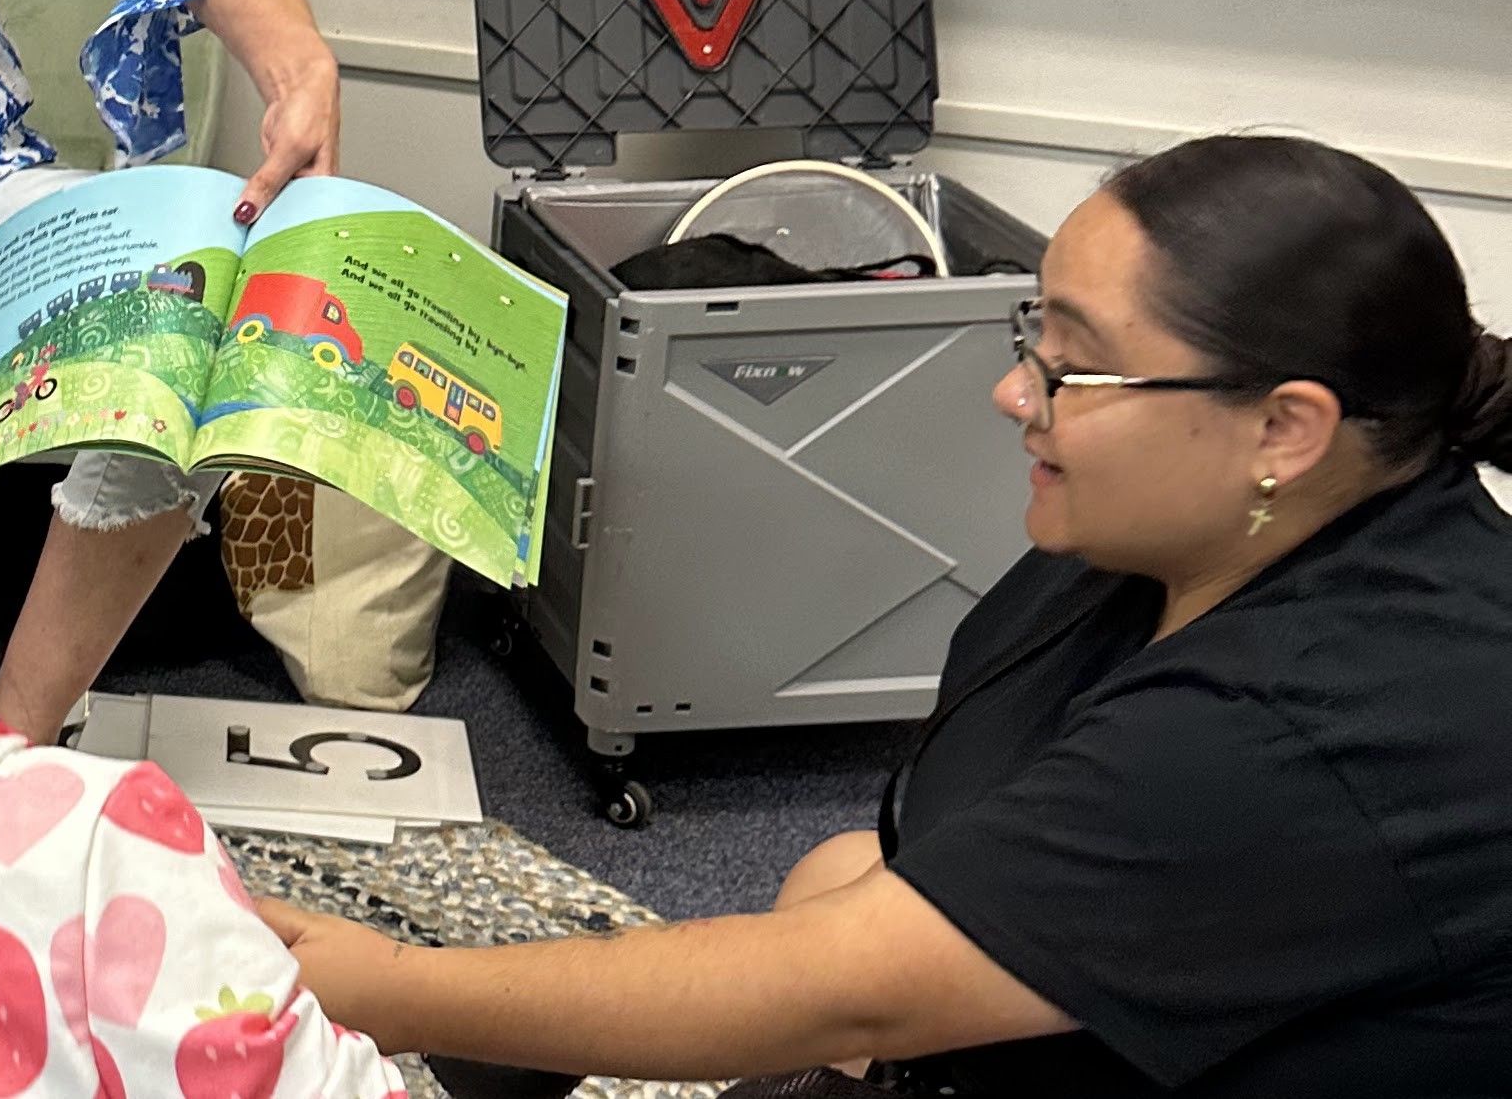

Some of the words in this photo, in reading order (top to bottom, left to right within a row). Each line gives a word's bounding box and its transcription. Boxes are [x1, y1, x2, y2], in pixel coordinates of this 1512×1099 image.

[341, 268, 365, 284] And
[369, 280, 384, 292] we
[387, 291, 401, 302] all
[404, 301, 416, 312] go
[345, 255, 368, 270] And
[372, 268, 387, 280] we
[391, 278, 404, 290] all
[406, 288, 419, 299] go
[226, 724, 422, 781] 5
